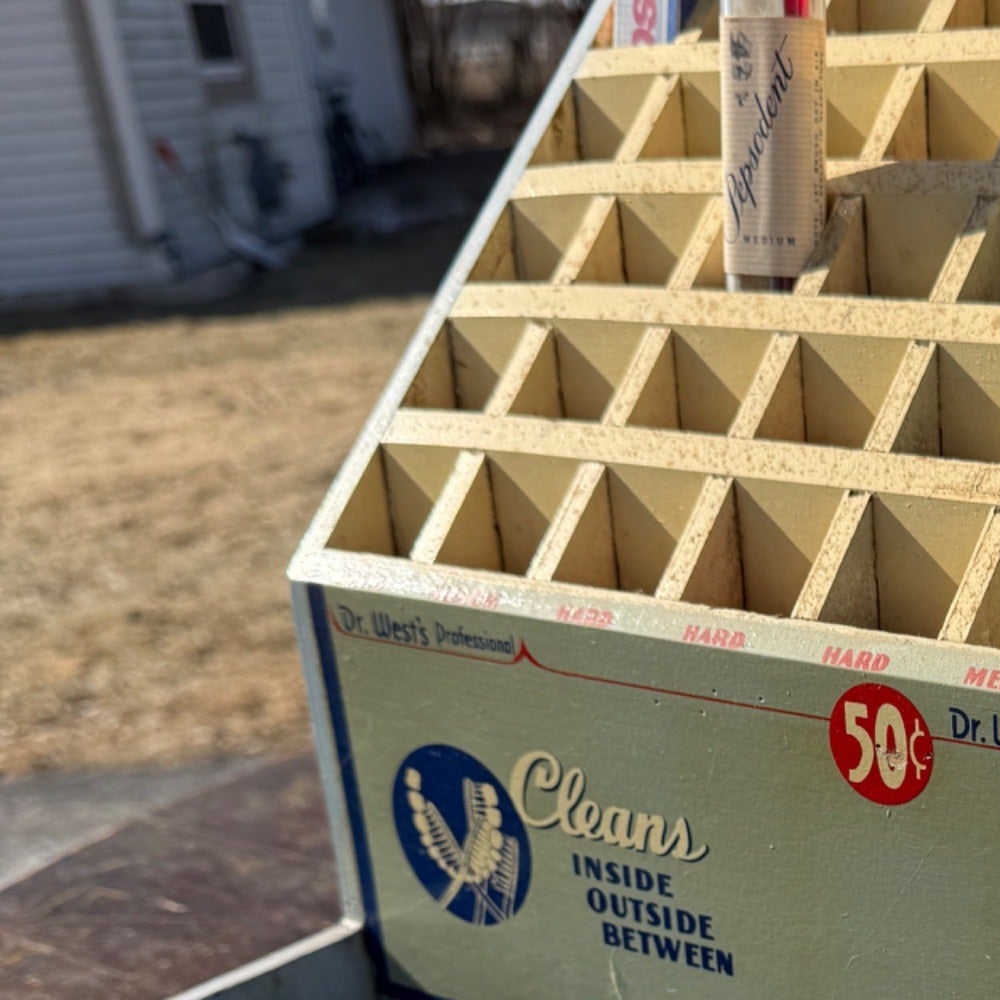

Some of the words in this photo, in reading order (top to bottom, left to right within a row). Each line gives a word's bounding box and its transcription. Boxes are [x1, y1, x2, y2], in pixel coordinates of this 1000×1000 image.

[744, 234, 796, 246] MEDIUM
[338, 605, 368, 636] Dr.
[373, 613, 430, 647] West's
[436, 622, 516, 656] Professional
[683, 625, 746, 650] HARD
[822, 646, 890, 672] HARD
[844, 701, 928, 790] 50¢
[948, 707, 986, 744] Dr.
[511, 751, 710, 863] Cleans
[572, 853, 674, 898] INSIDE
[586, 887, 715, 940] OUTSIDE
[602, 922, 735, 977] BETWEEN
